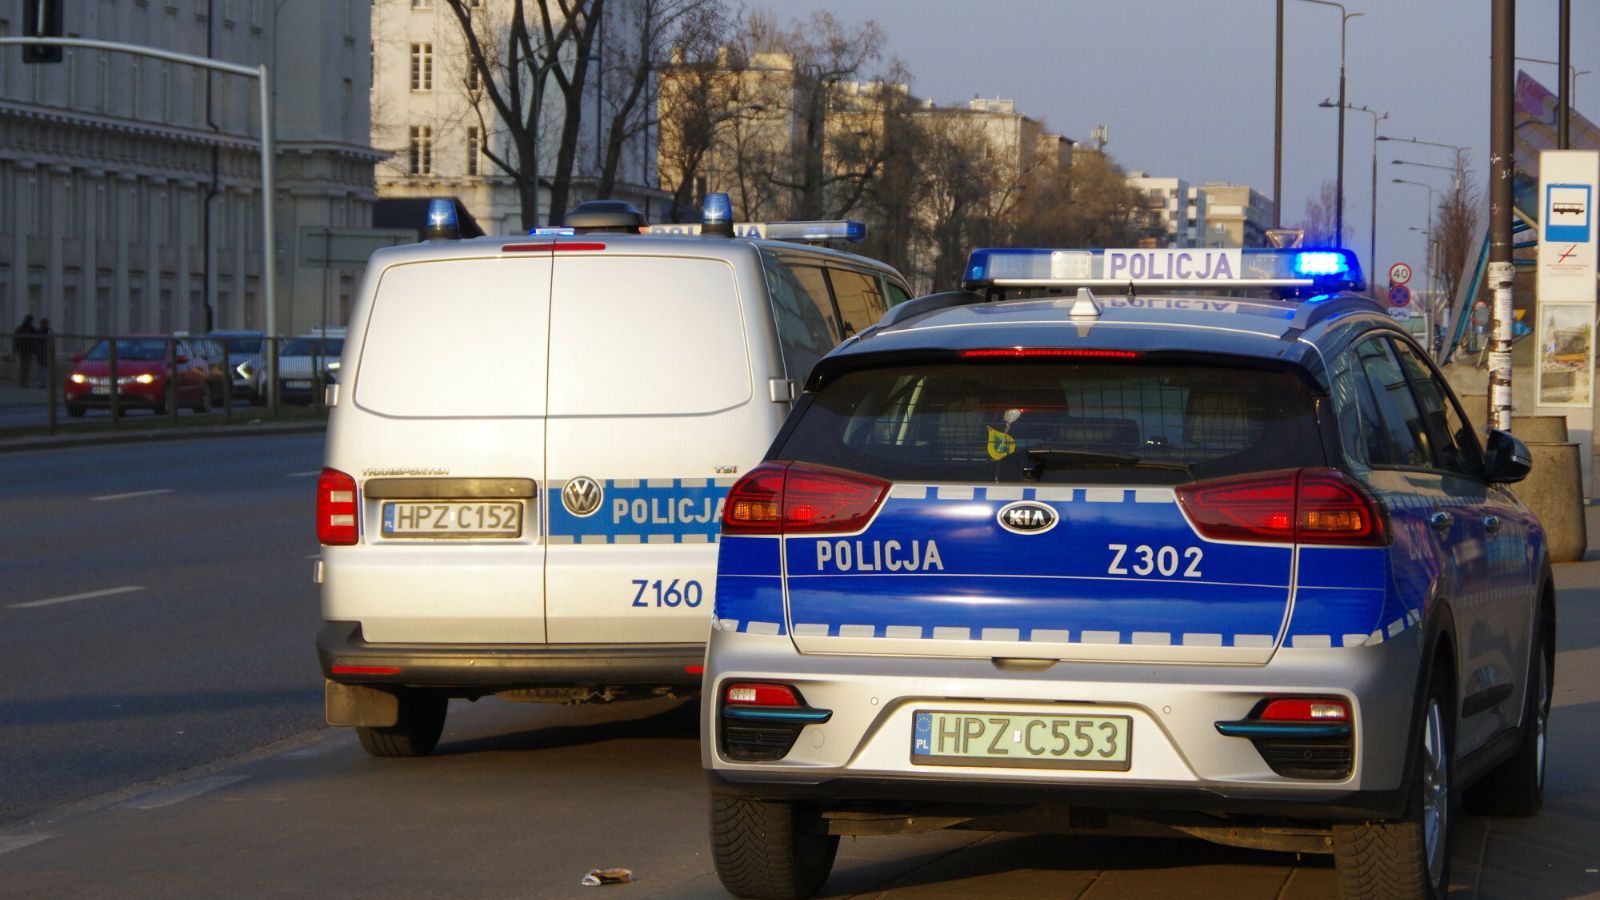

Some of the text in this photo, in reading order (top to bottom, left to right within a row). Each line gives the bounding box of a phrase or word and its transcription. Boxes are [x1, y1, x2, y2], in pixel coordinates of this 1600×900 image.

[1110, 252, 1233, 279] POLICJA
[1393, 268, 1408, 279] 40
[398, 505, 516, 529] HPZ C152
[1008, 509, 1046, 526] KIA
[816, 540, 944, 571] POLICJA
[1107, 543, 1204, 578] Z302
[631, 578, 703, 608] Z160
[916, 738, 929, 750] PL
[937, 716, 1118, 758] HPZ C553
